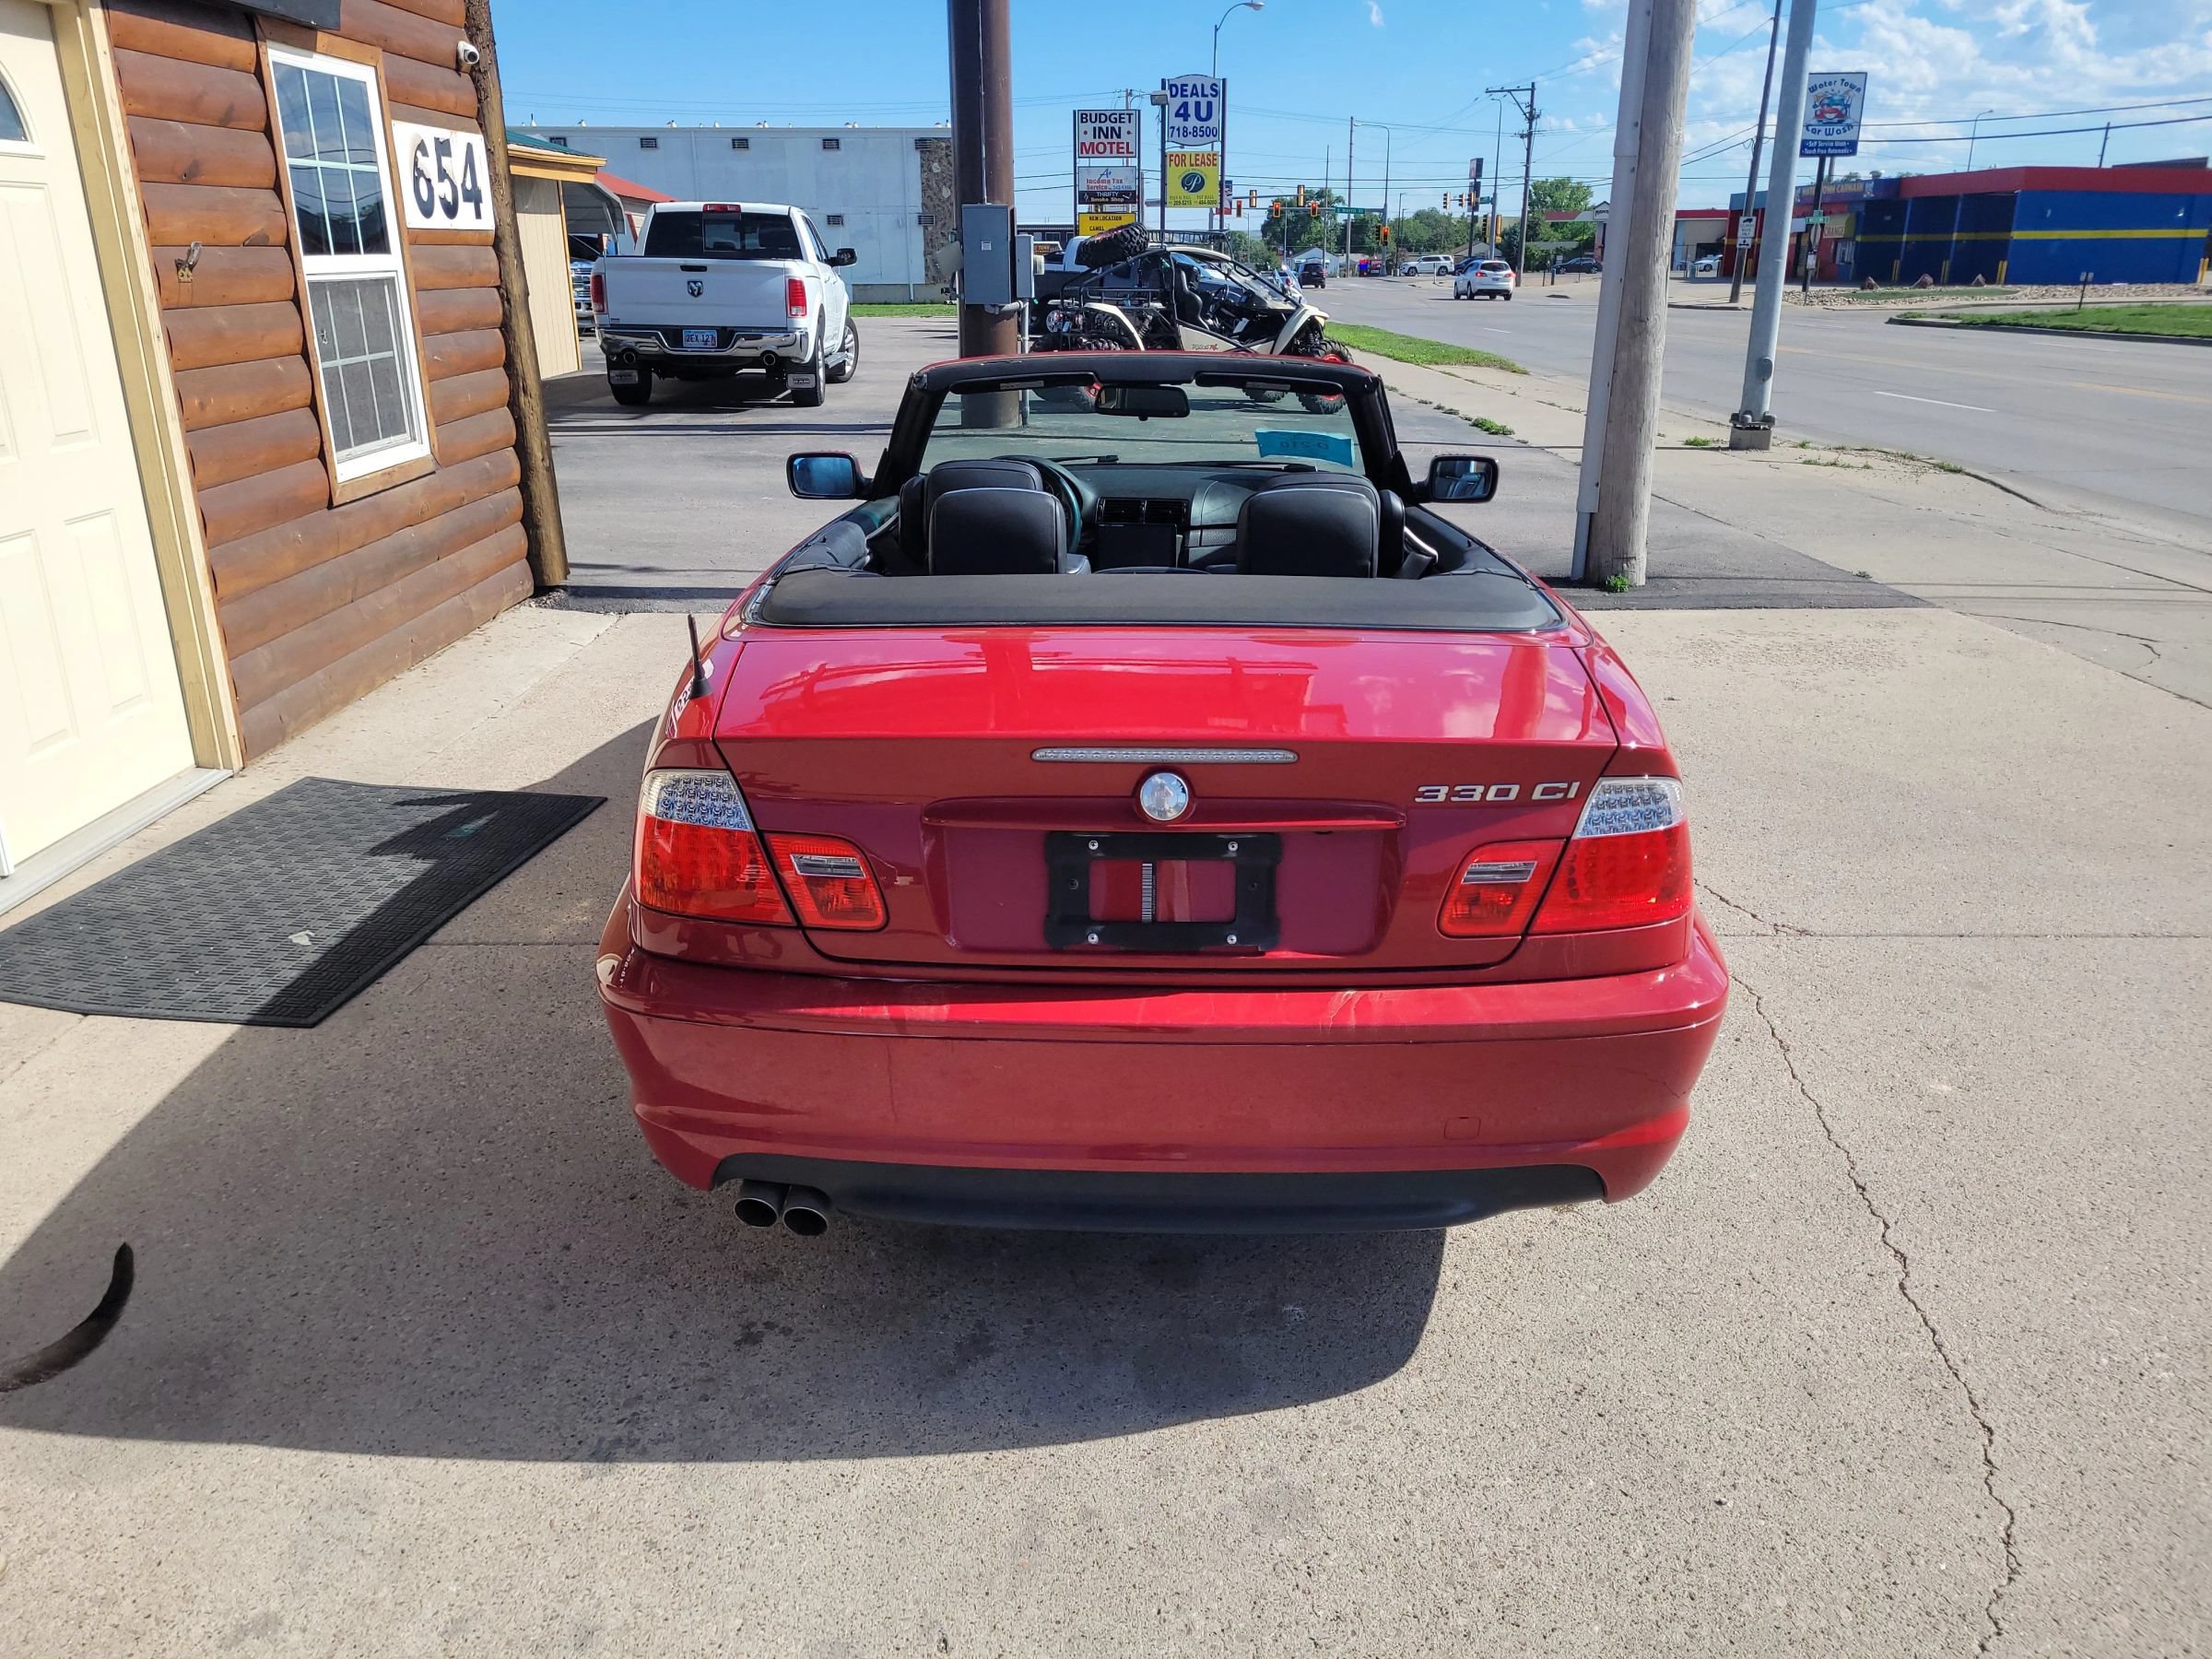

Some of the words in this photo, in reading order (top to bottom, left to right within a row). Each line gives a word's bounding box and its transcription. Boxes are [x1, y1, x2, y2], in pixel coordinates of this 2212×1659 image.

[1170, 83, 1218, 98] DEALS
[1808, 80, 1837, 93] Water
[1841, 78, 1861, 93] Town
[1080, 112, 1134, 124] BUDGET
[1093, 126, 1121, 139] INN
[1806, 124, 1821, 135] Car
[1825, 124, 1853, 136] Wash
[1080, 142, 1134, 154] MOTEL
[1169, 154, 1187, 167] FOR
[1190, 154, 1218, 167] LEASE
[413, 137, 483, 219] 654
[1415, 784, 1521, 803] 330
